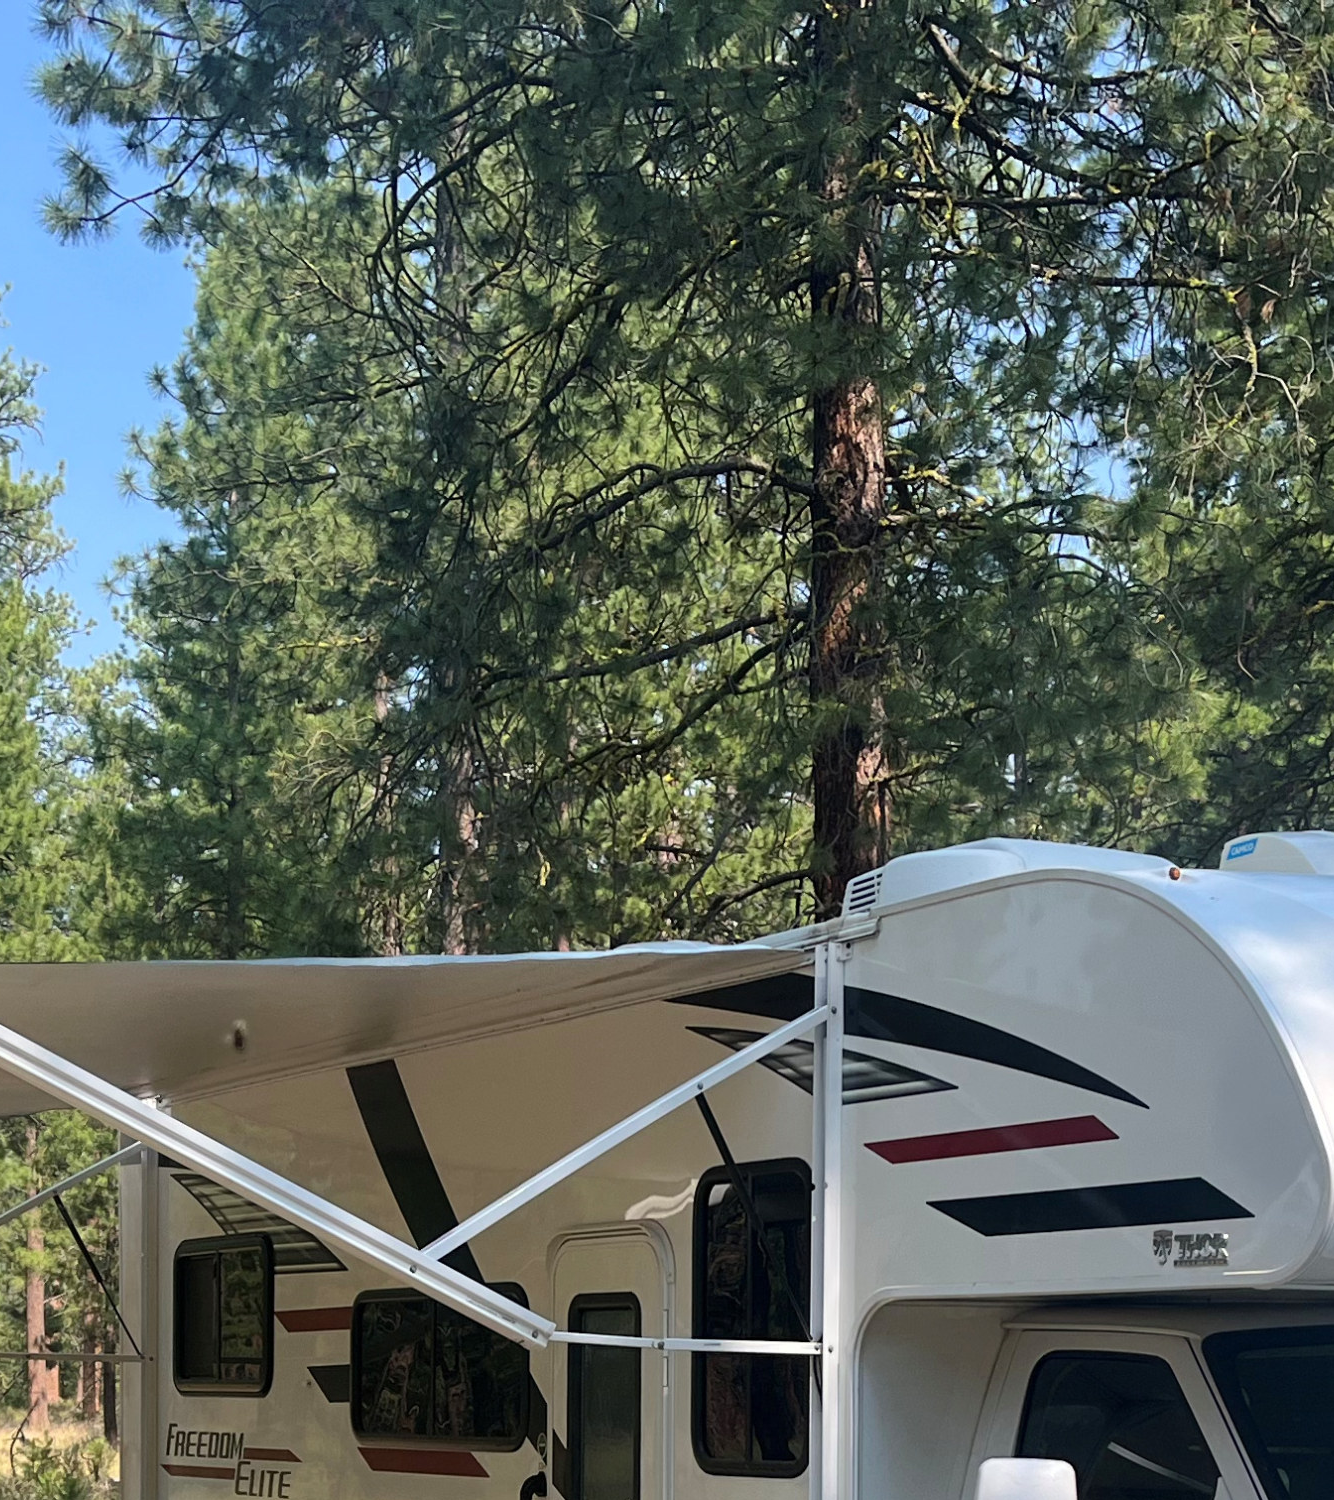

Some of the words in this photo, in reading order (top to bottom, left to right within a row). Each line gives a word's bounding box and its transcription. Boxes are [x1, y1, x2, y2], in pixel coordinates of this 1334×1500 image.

[1174, 1232, 1228, 1260] THOR
[166, 1423, 244, 1460] FREEDOM
[235, 1461, 292, 1499] ELITE
